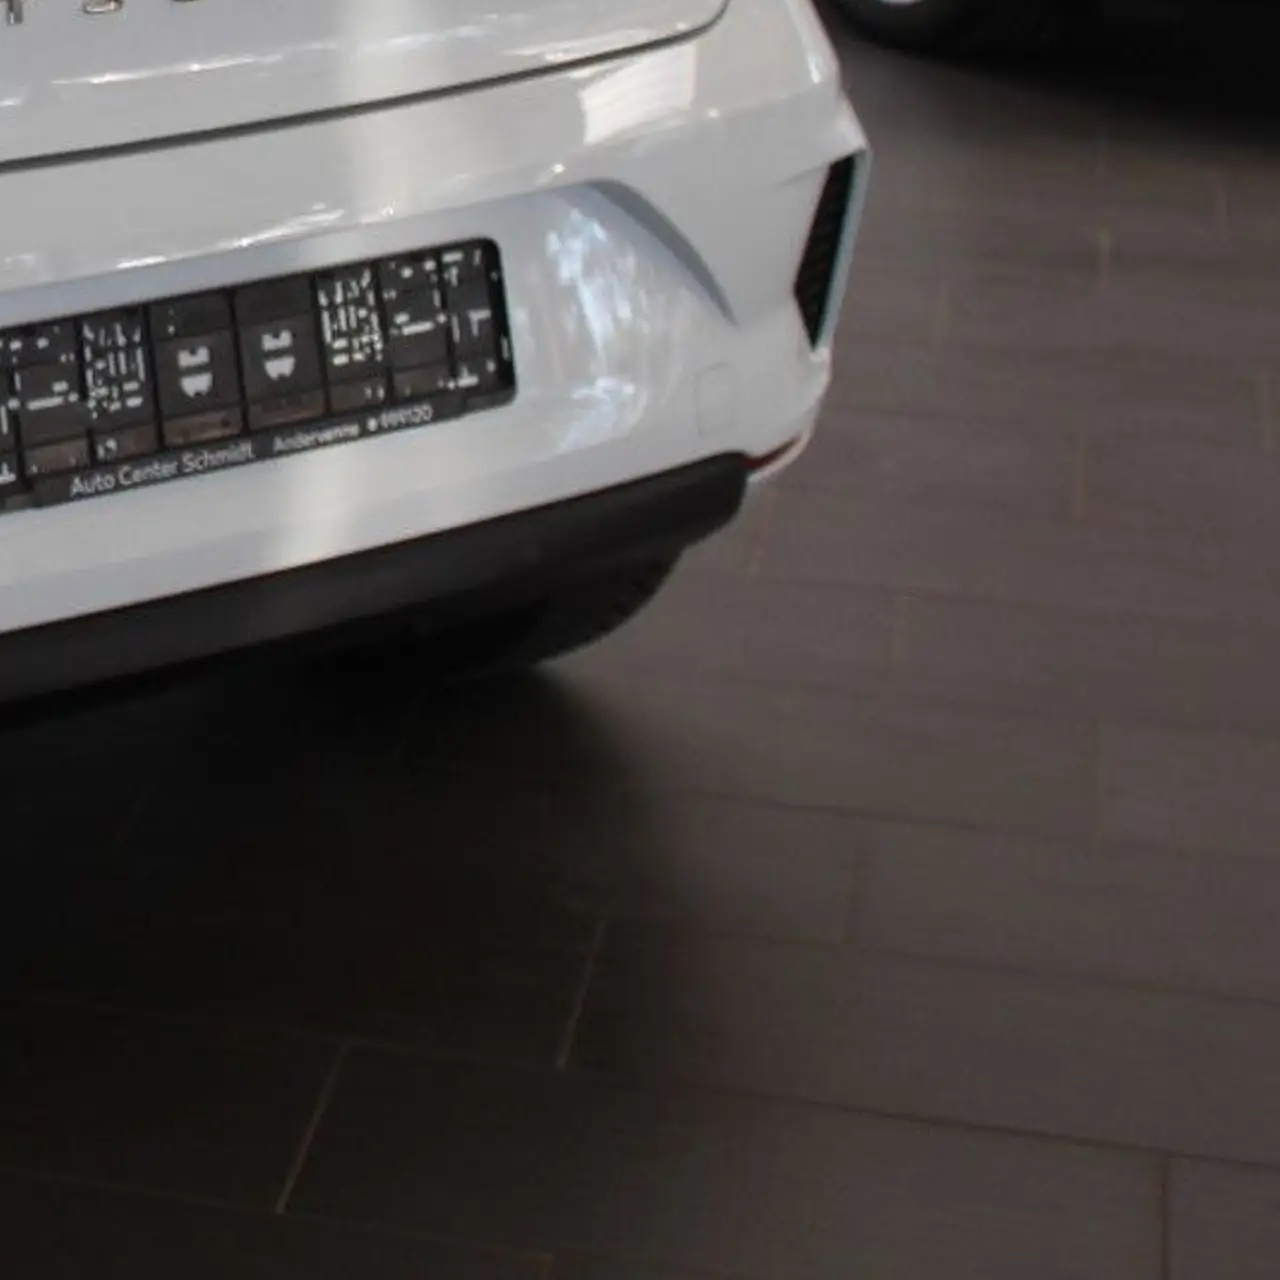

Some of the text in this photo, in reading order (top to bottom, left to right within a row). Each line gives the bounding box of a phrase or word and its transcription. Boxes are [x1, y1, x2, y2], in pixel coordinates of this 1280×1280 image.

[69, 473, 117, 497] Auto
[118, 459, 180, 486] Center
[182, 440, 256, 473] Schmidt
